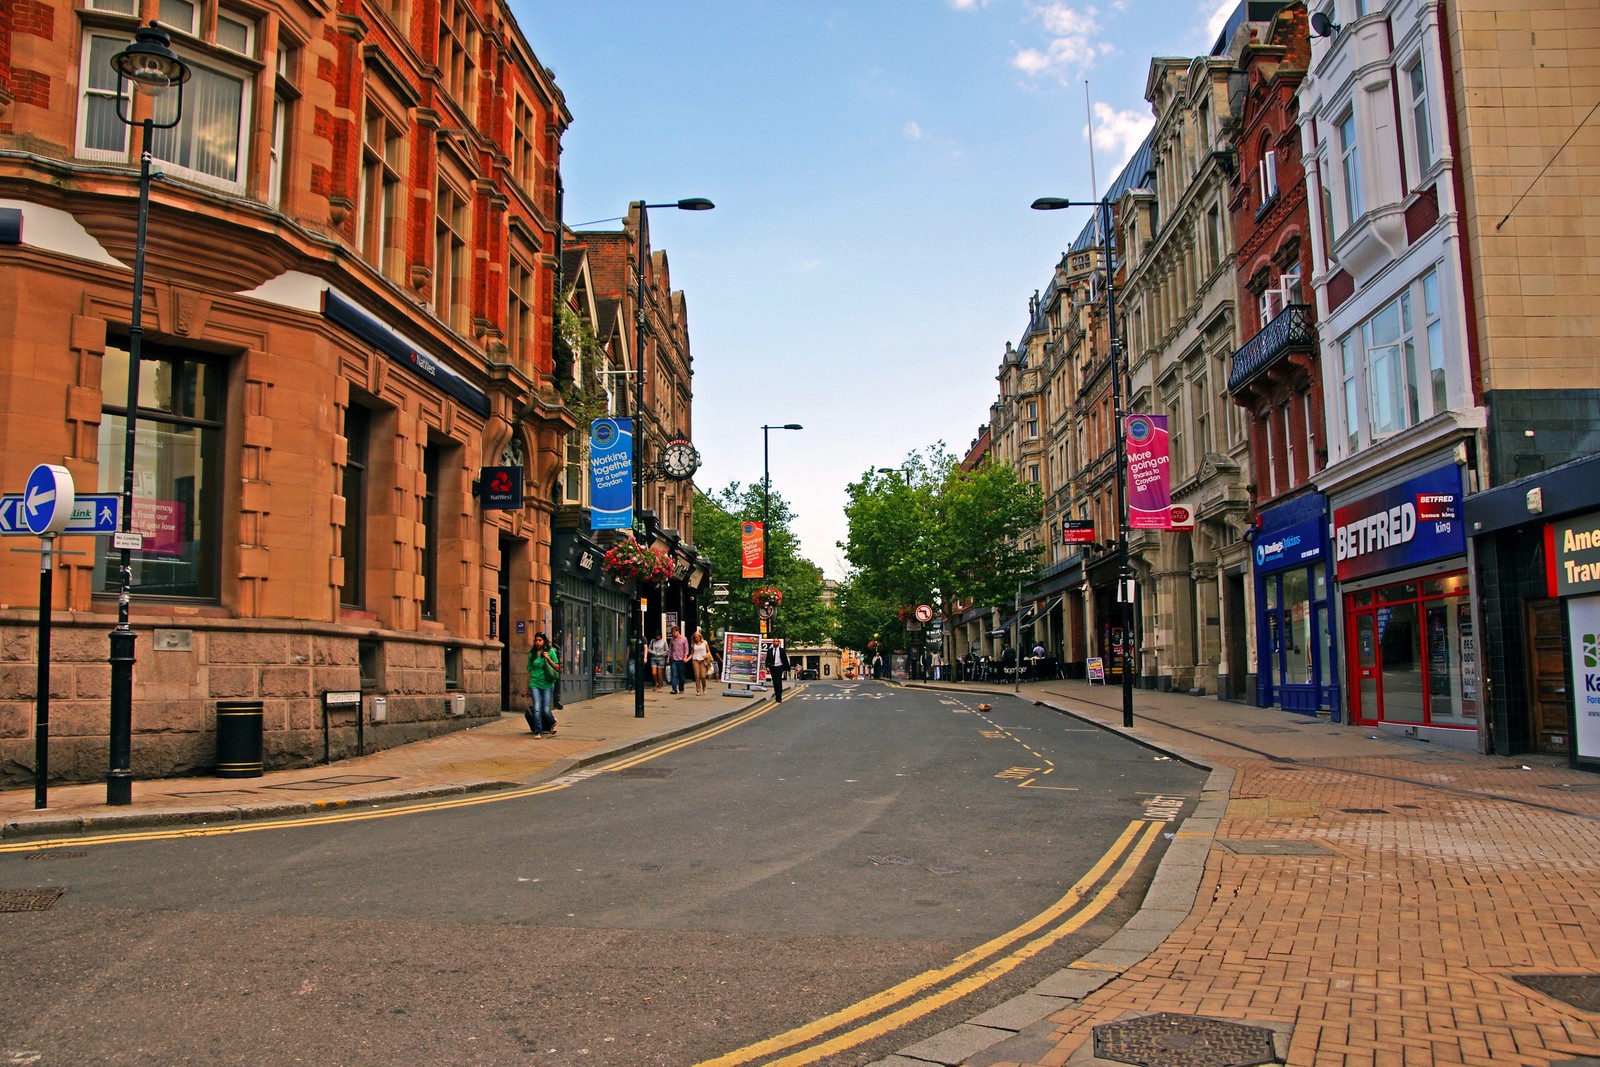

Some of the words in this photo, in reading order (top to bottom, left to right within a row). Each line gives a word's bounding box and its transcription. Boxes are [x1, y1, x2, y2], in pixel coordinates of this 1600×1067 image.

[591, 451, 627, 467] Working
[1128, 450, 1151, 463] More
[593, 459, 632, 475] together
[1131, 459, 1157, 473] going
[1157, 455, 1169, 464] on
[595, 474, 604, 483] for
[610, 470, 628, 480] better
[1133, 471, 1152, 480] thanks
[1135, 476, 1160, 485] Croydon
[597, 478, 623, 489] Croydon
[1137, 484, 1147, 492] BID
[1420, 495, 1454, 504] BETFRED
[134, 503, 173, 513] emergency
[138, 511, 155, 519] from
[141, 520, 146, 528] if
[147, 521, 160, 530] you
[161, 522, 176, 531] lose
[1435, 521, 1451, 534] king
[1337, 502, 1416, 561] BETFRED
[1463, 640, 1474, 650] BES
